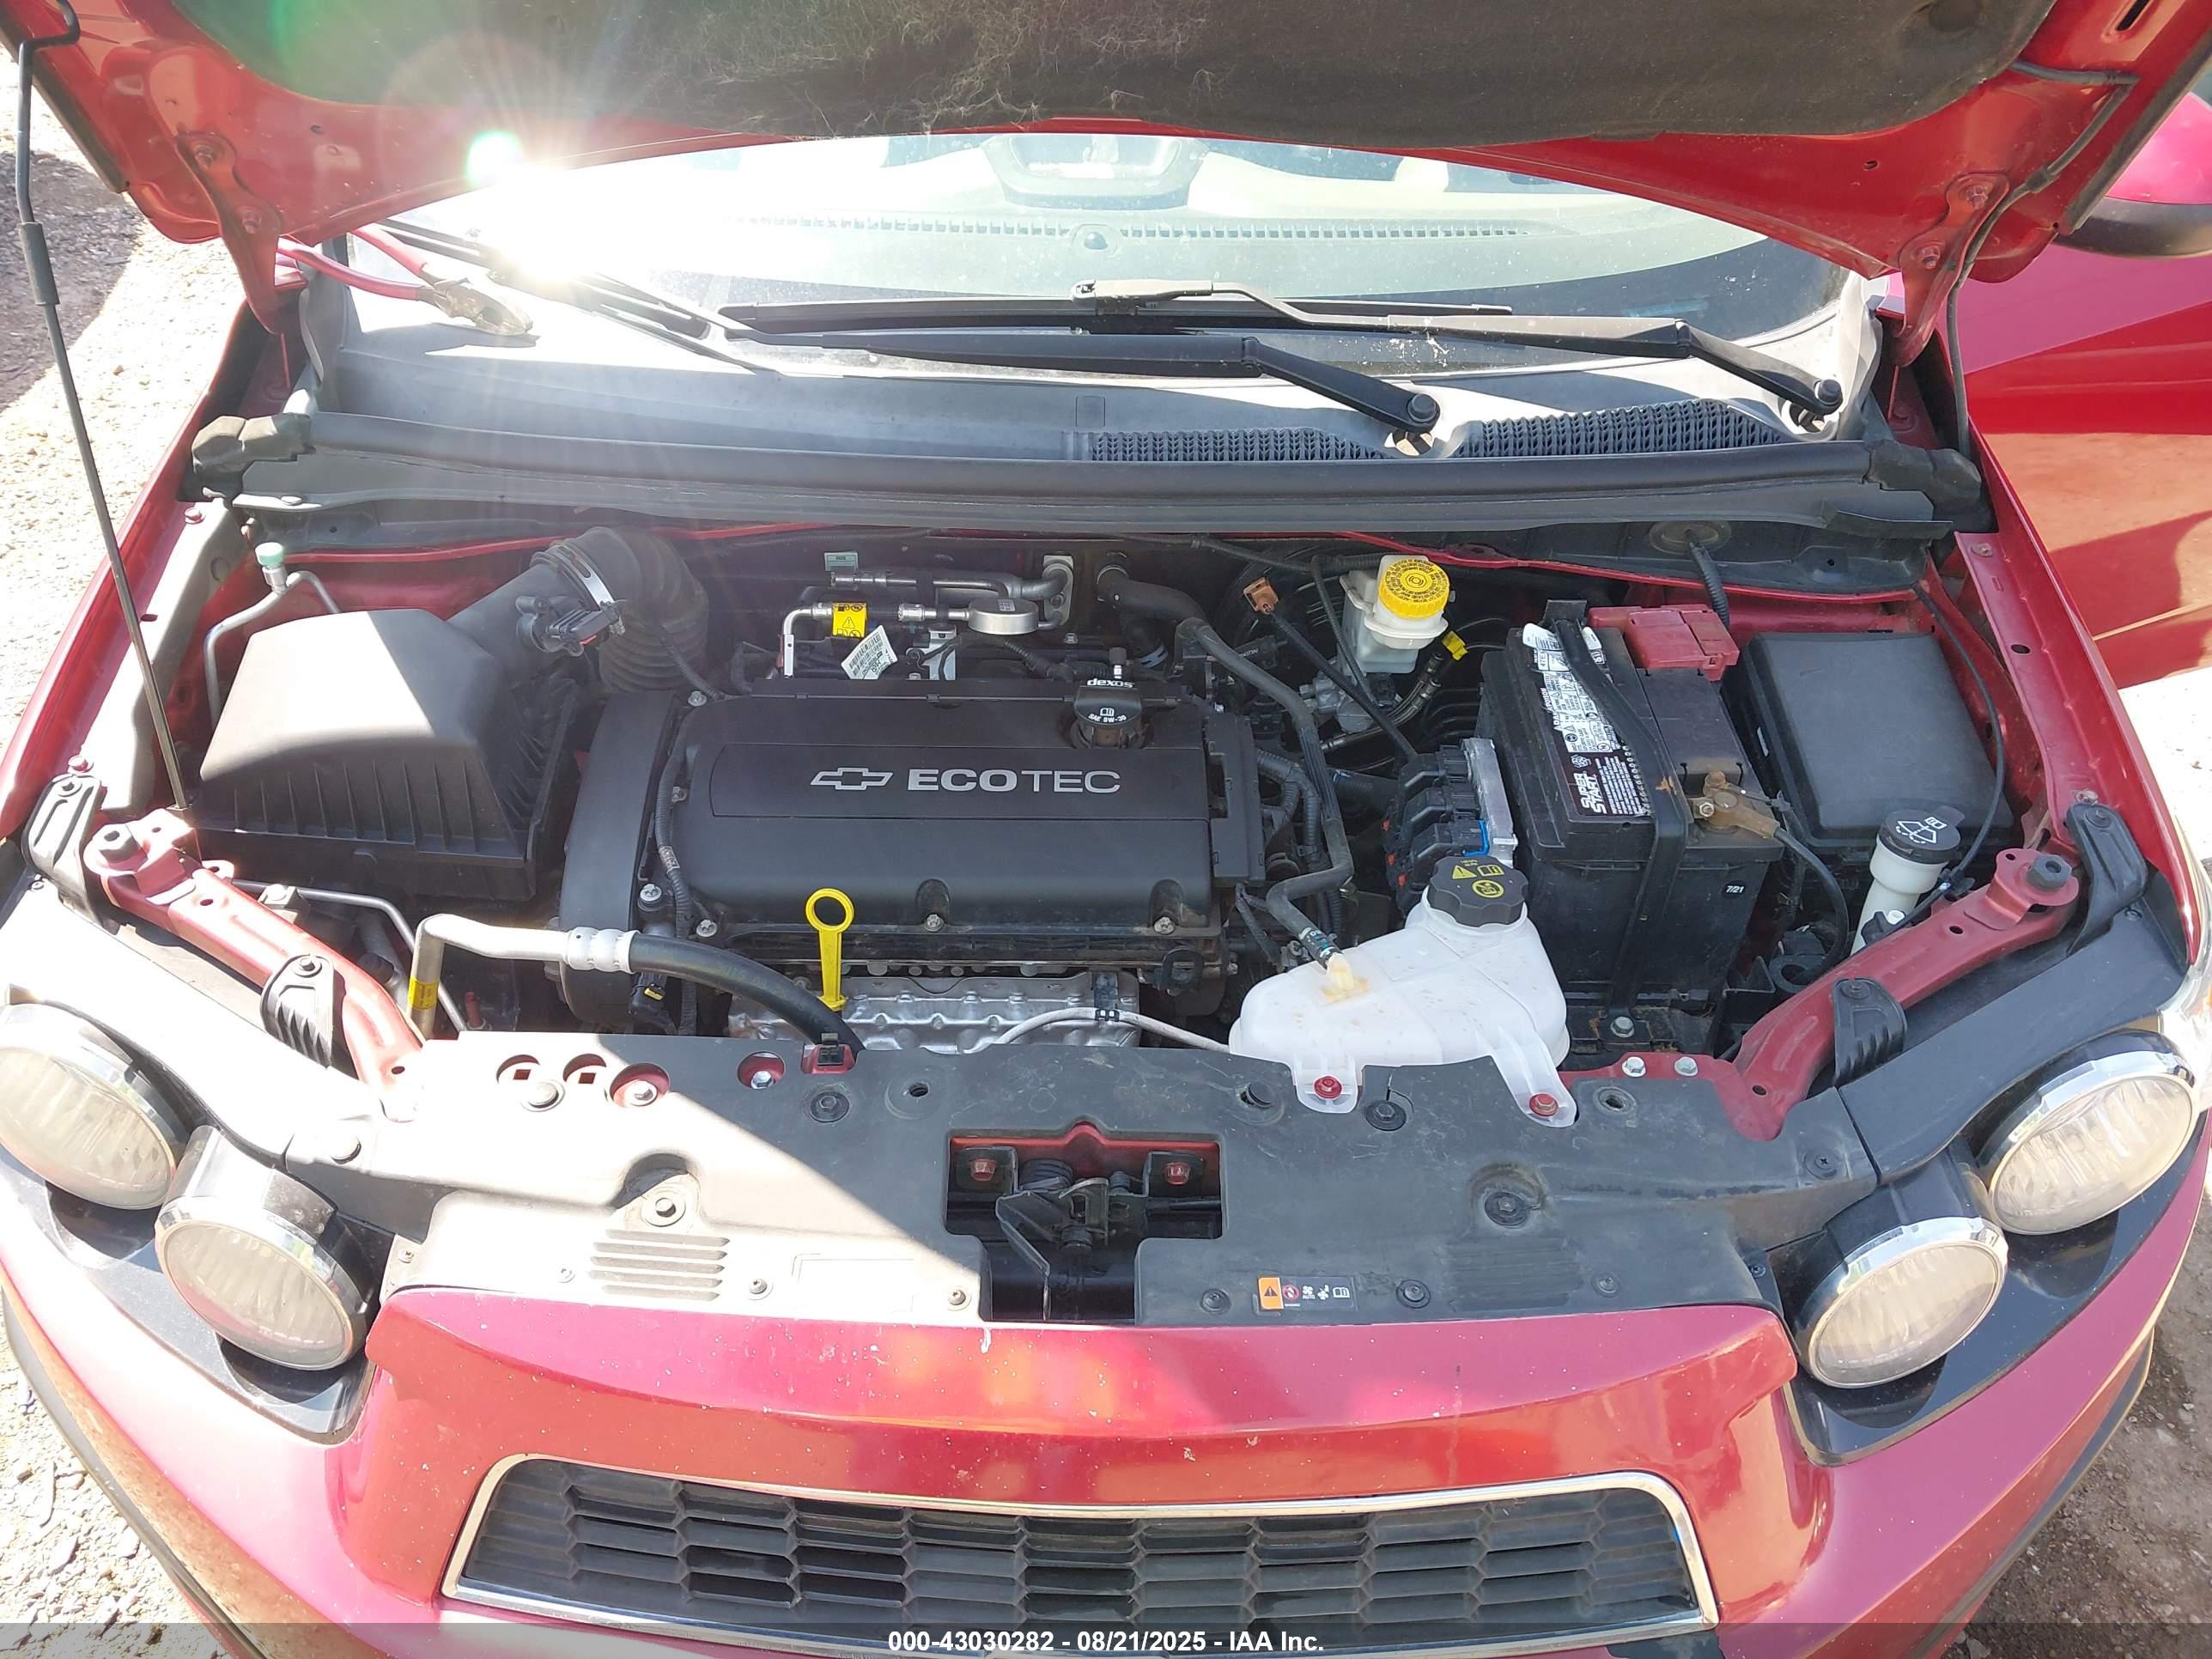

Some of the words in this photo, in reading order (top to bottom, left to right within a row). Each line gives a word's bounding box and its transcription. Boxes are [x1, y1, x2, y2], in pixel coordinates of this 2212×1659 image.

[1087, 678, 1134, 688] dexos
[1088, 714, 1101, 722] SAE
[908, 769, 1121, 793] ECOTEC
[1573, 772, 1591, 809] SUPER
[1583, 772, 1607, 814] START
[1726, 885, 1745, 894] 7/21
